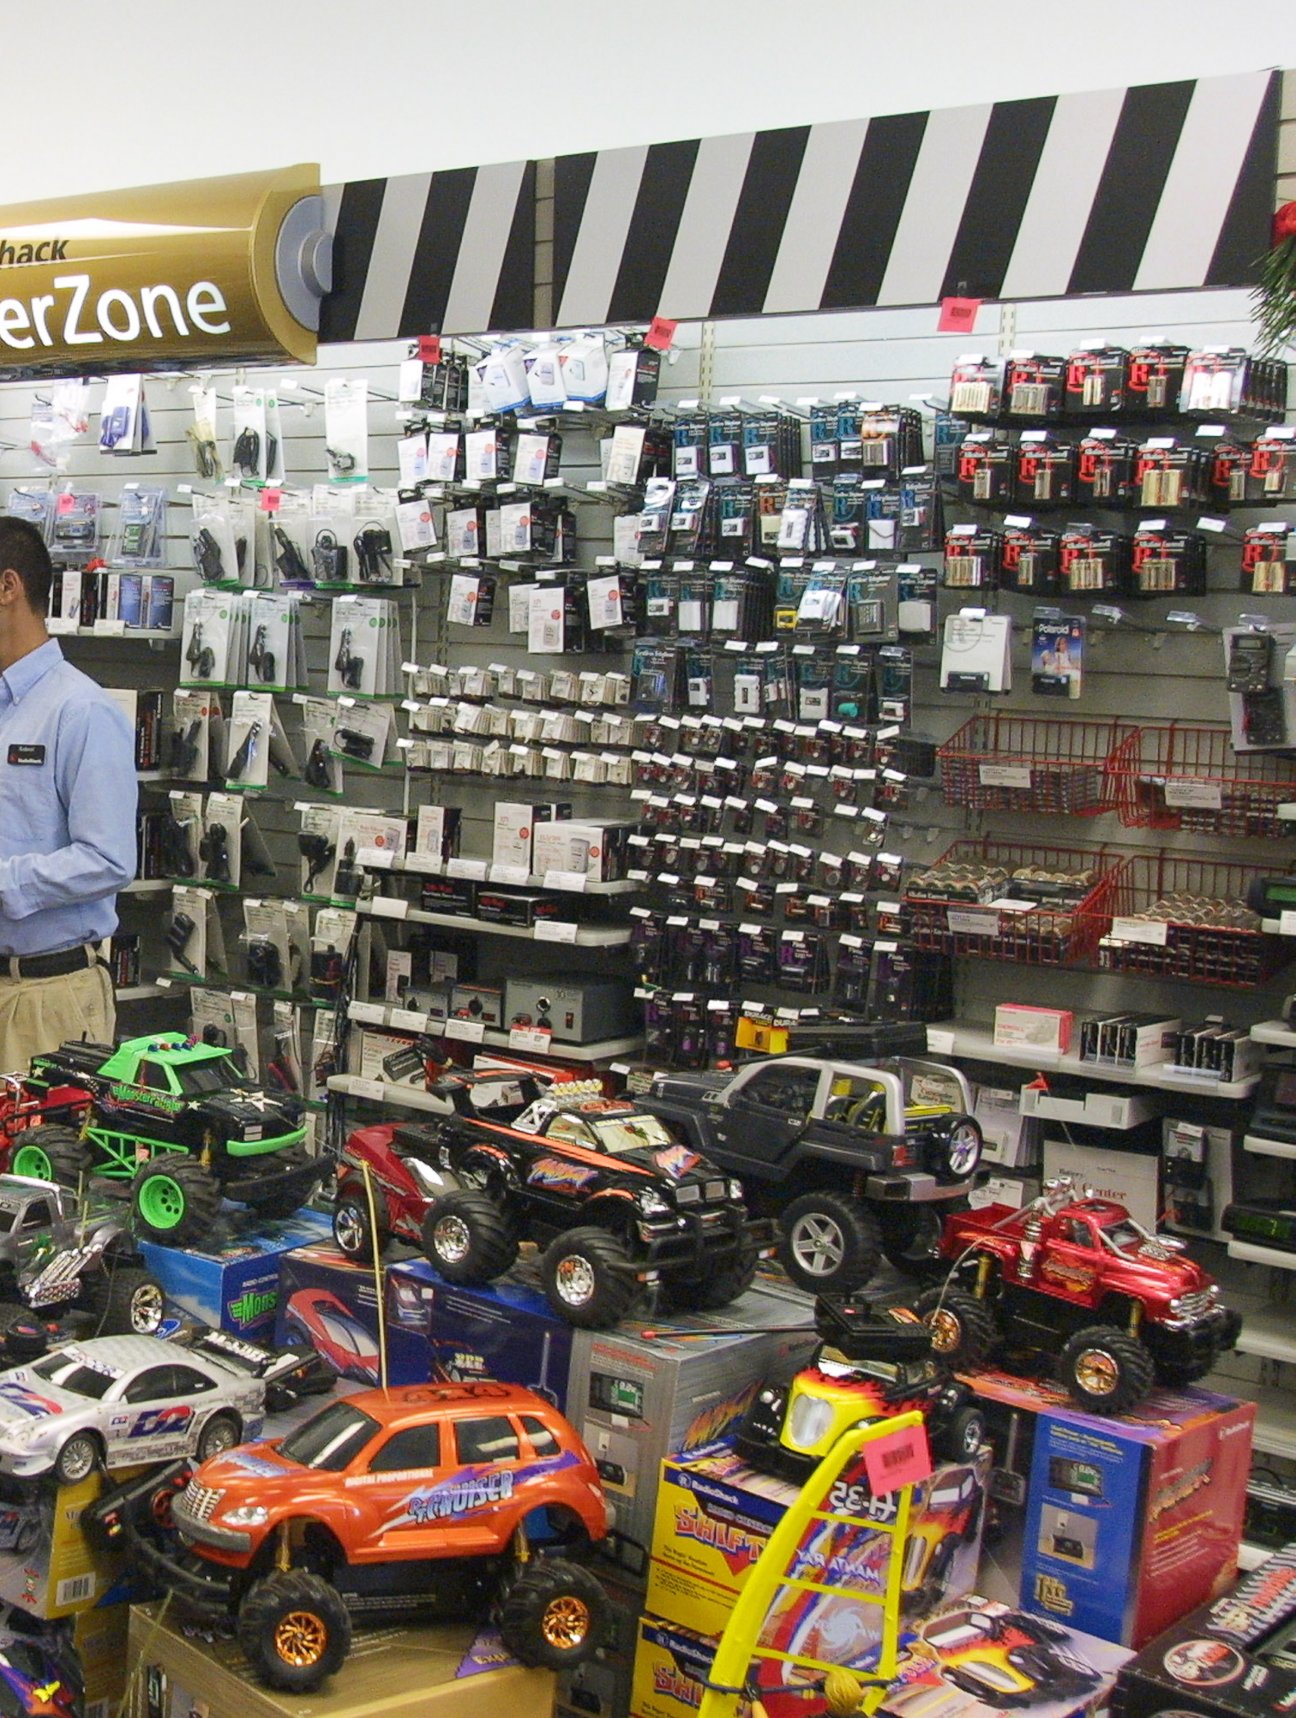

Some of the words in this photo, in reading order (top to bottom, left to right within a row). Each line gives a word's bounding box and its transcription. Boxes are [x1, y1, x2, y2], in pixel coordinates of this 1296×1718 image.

[1038, 624, 1070, 635] Polaroid
[127, 1405, 193, 1438] D2
[374, 1468, 434, 1485] PROPORTIONAL
[691, 1480, 739, 1506] RadioShack
